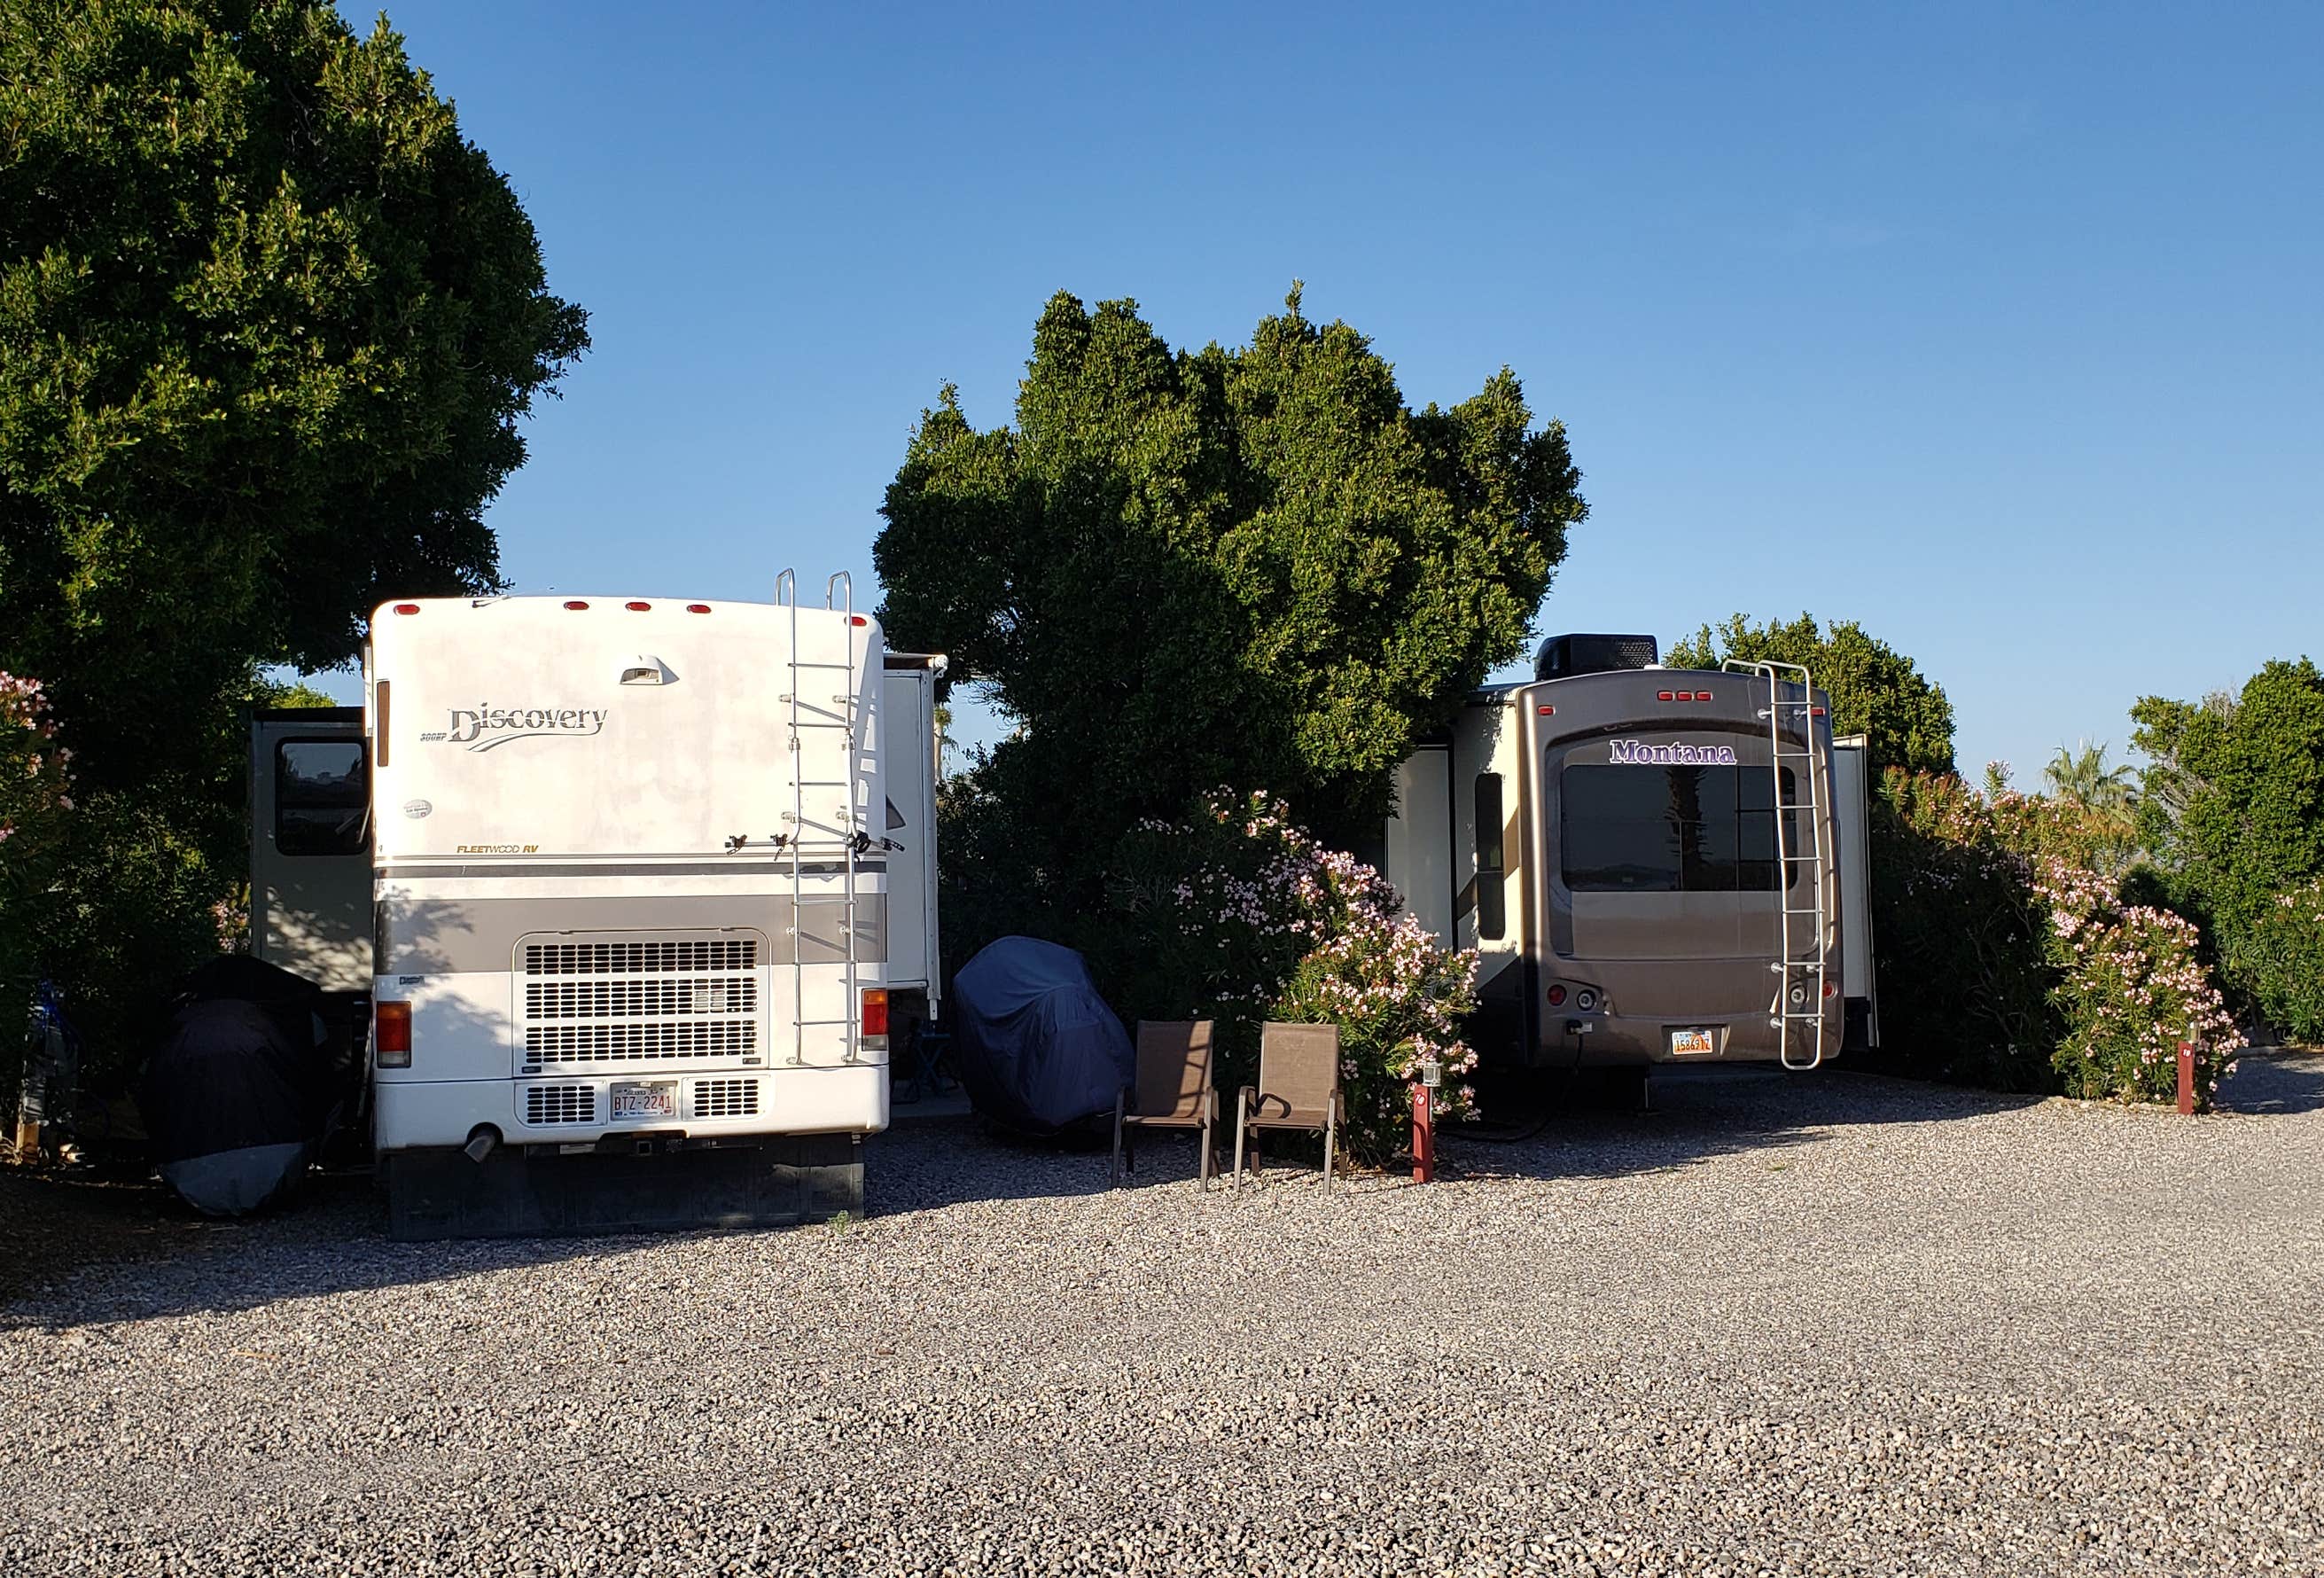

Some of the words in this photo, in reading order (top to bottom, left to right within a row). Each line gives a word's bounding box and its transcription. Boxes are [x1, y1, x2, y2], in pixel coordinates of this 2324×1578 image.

[448, 701, 608, 743] Discovery
[1610, 739, 1738, 766] Montana
[456, 845, 520, 854] FLEETWOOD
[522, 845, 539, 854] RV
[614, 1095, 672, 1111] BTZ-2241
